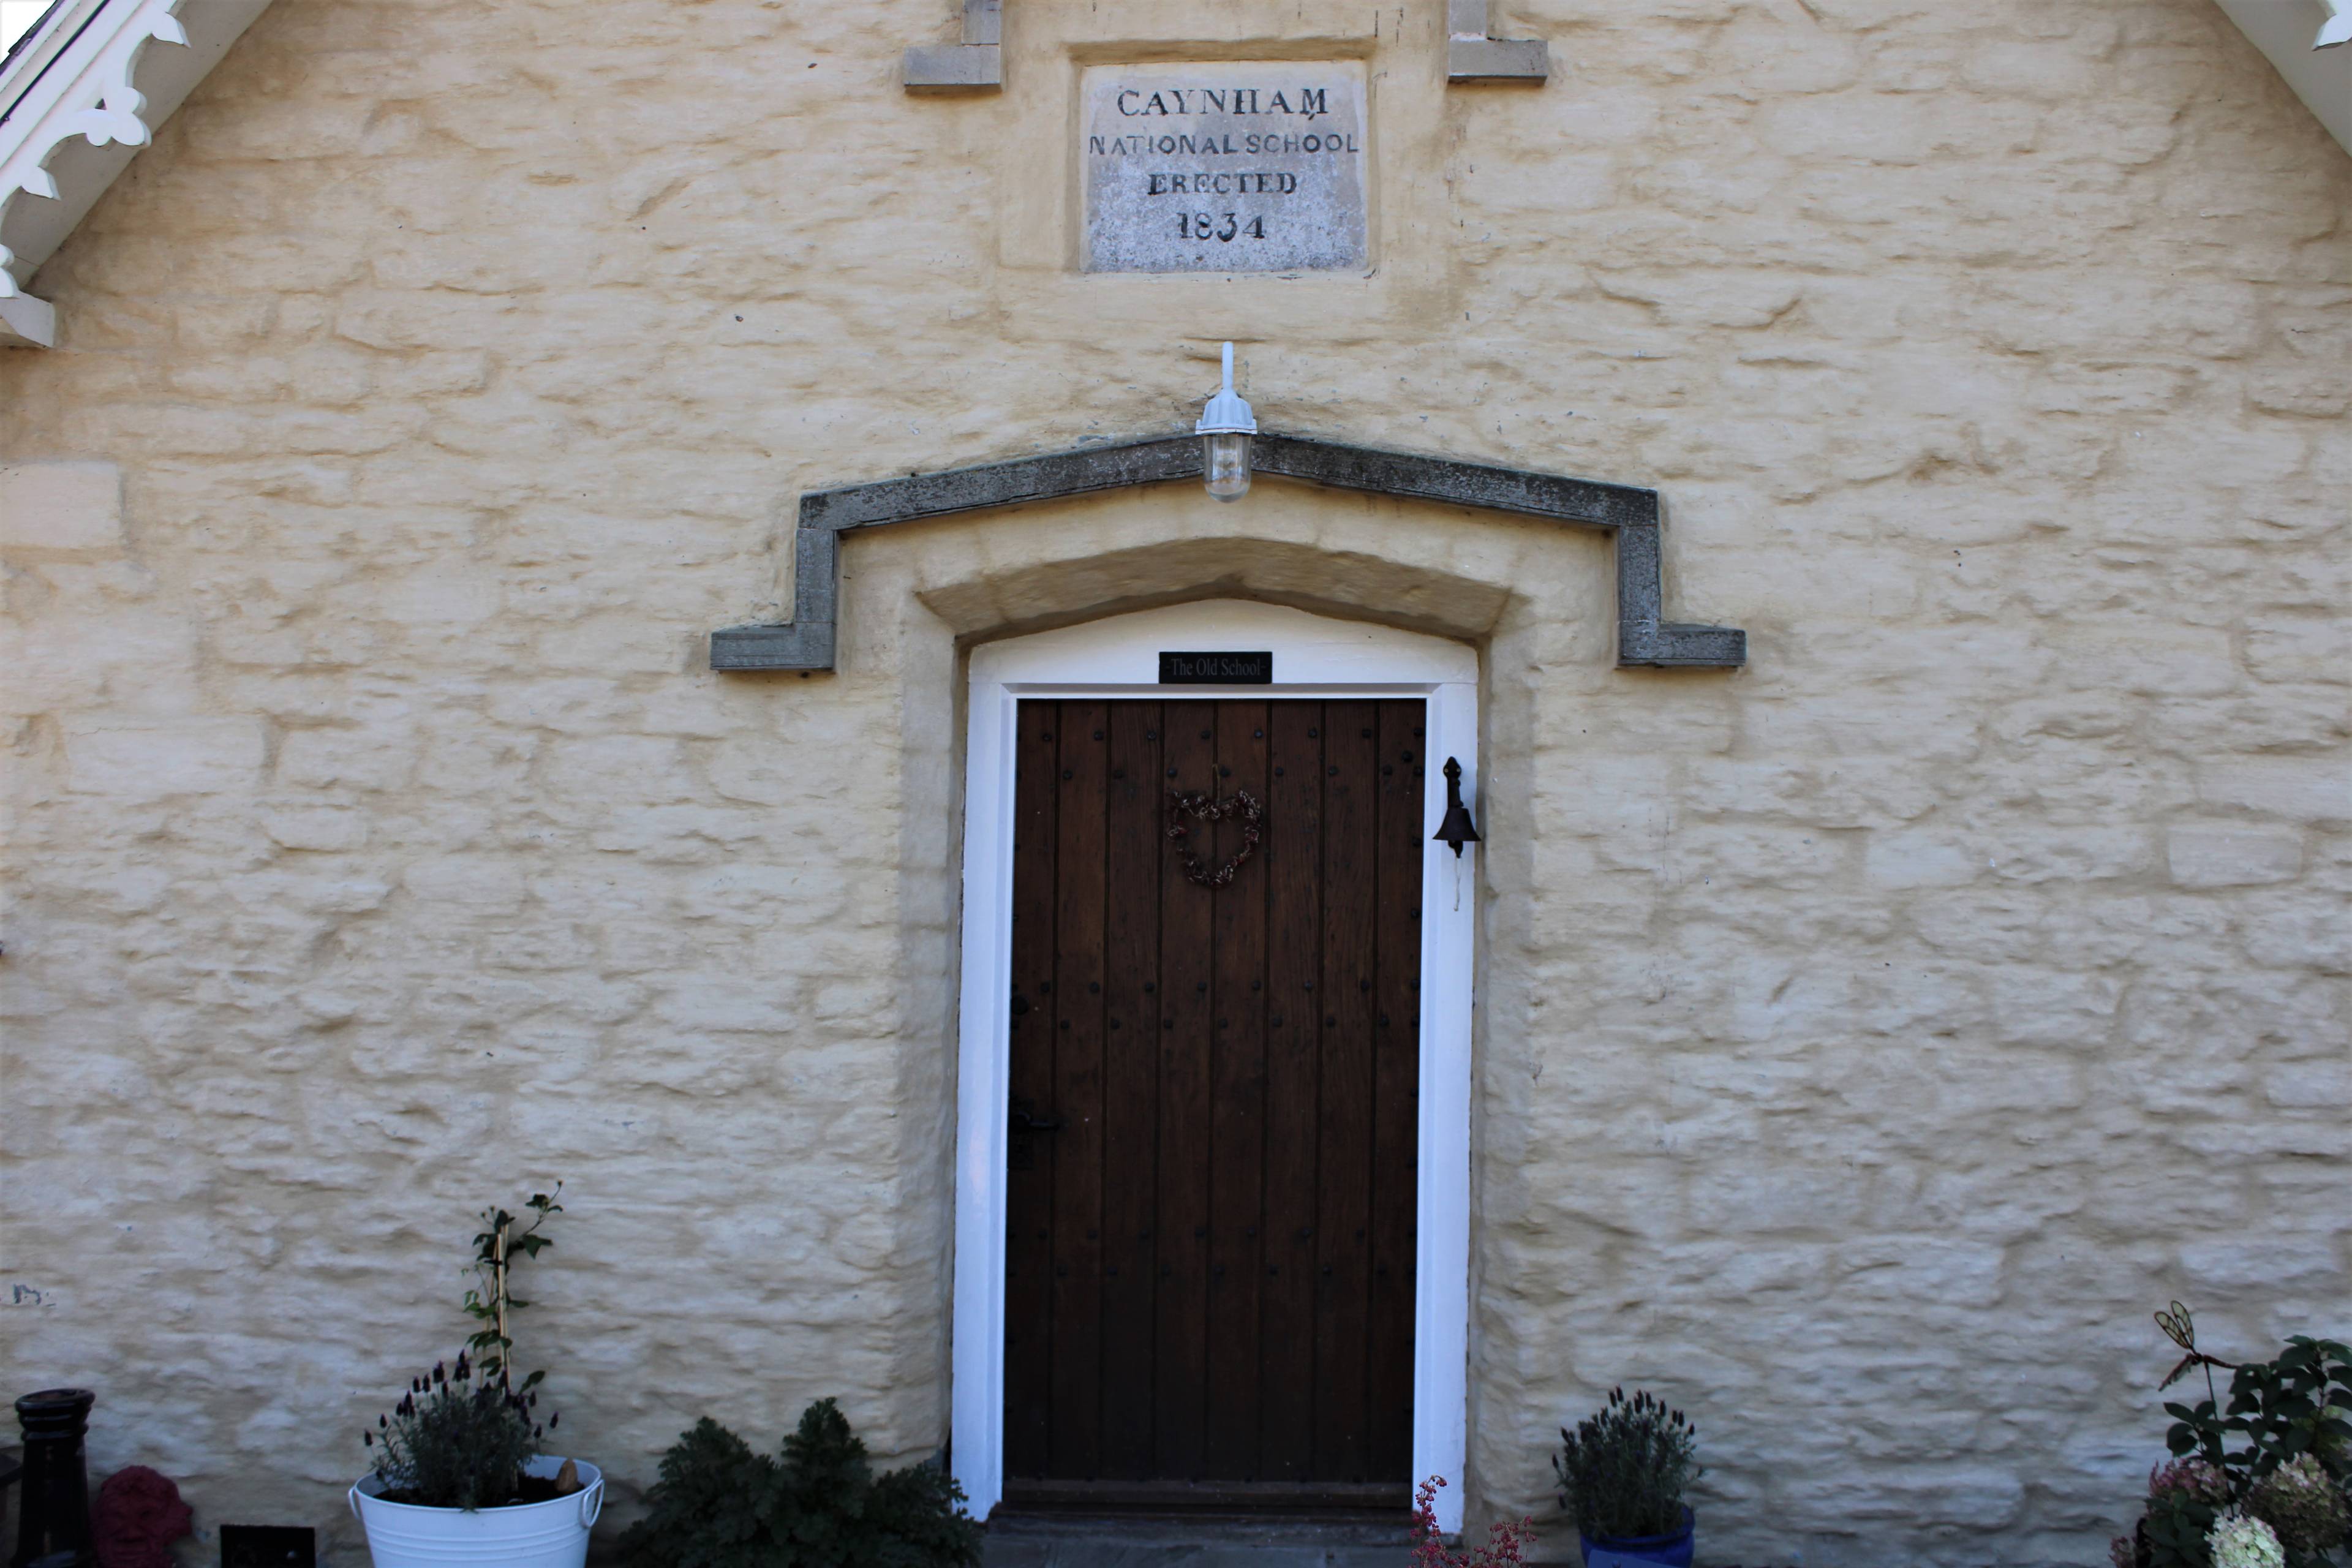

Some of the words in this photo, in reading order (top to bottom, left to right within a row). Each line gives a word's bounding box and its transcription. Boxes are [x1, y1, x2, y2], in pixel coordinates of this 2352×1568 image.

[1117, 89, 1329, 116] CAYNHAM
[1089, 134, 1238, 156] NATIONAL
[1246, 134, 1360, 155] SCHOOL
[1148, 173, 1298, 195] ERECTED
[1177, 212, 1265, 243] 1834
[1170, 658, 1193, 676] The
[1196, 658, 1218, 676] Old
[1221, 658, 1261, 676] School
